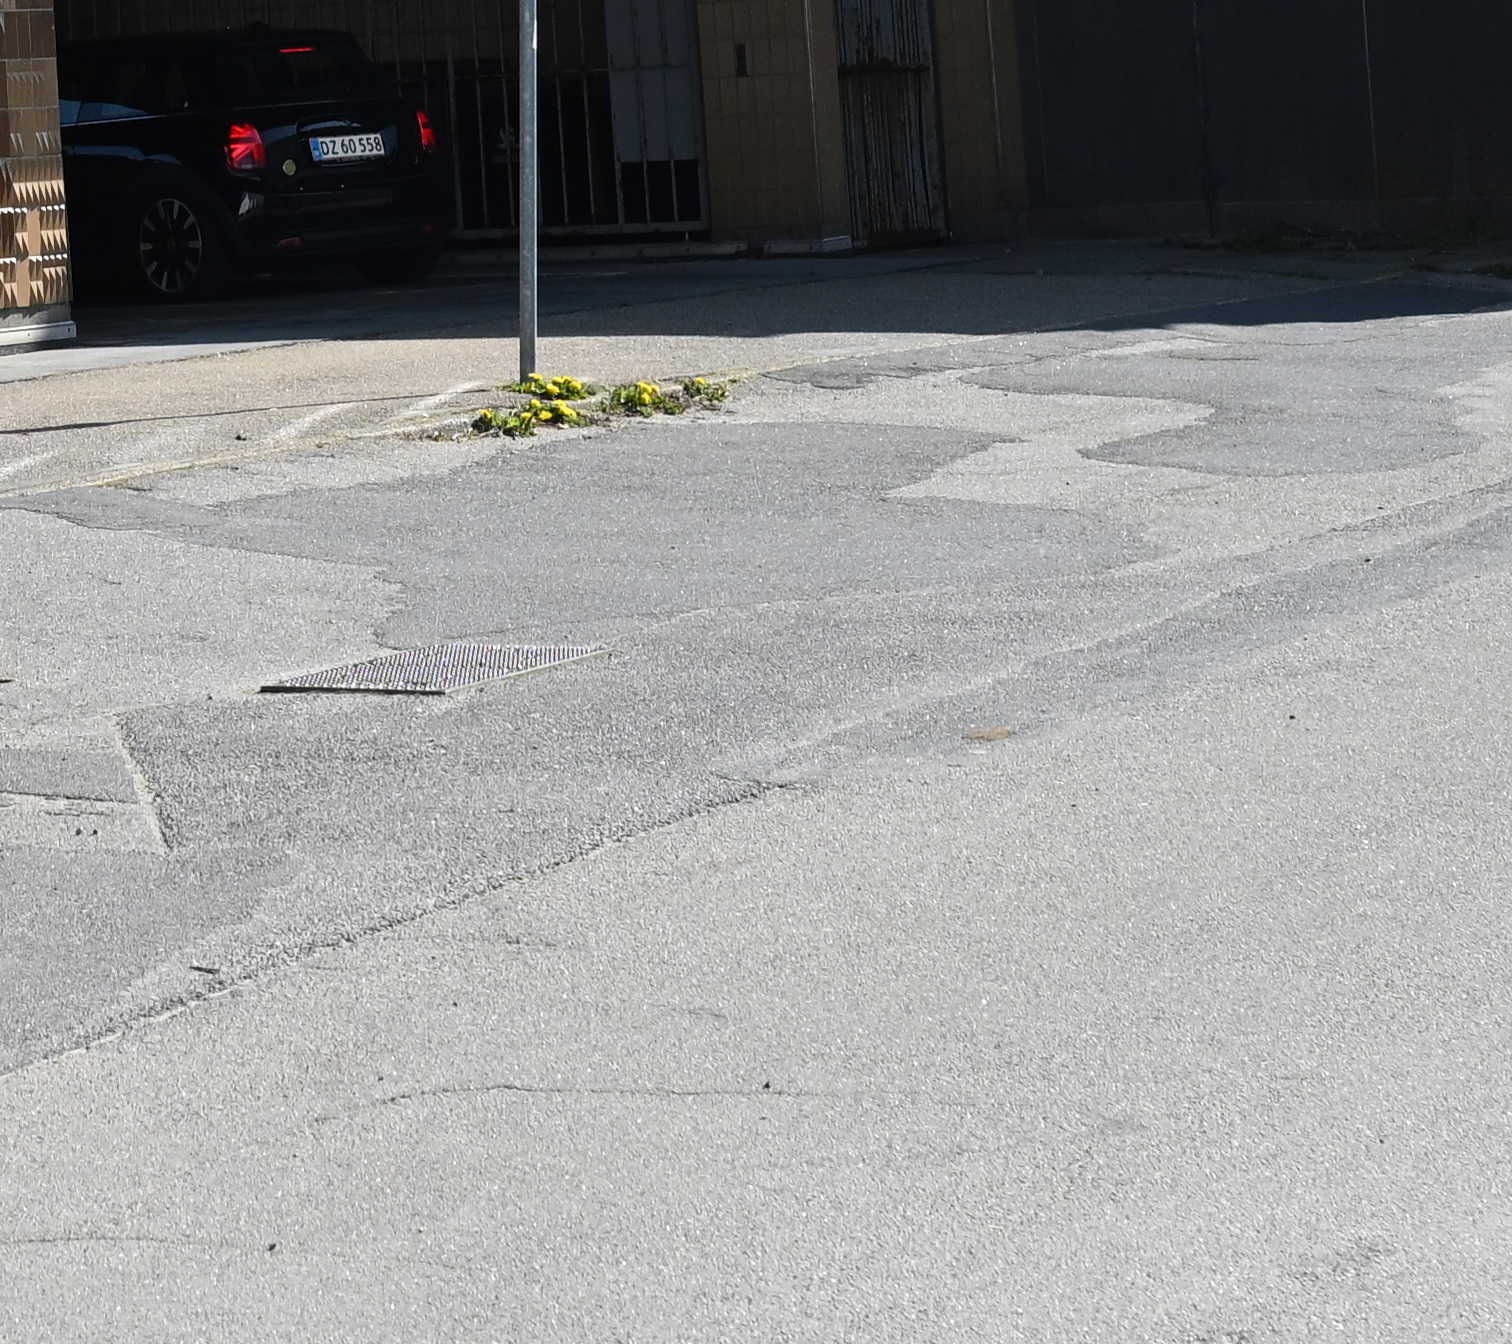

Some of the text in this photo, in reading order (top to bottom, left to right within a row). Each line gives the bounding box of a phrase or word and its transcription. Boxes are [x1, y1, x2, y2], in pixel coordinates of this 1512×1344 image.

[320, 136, 383, 156] DZ 60 558
